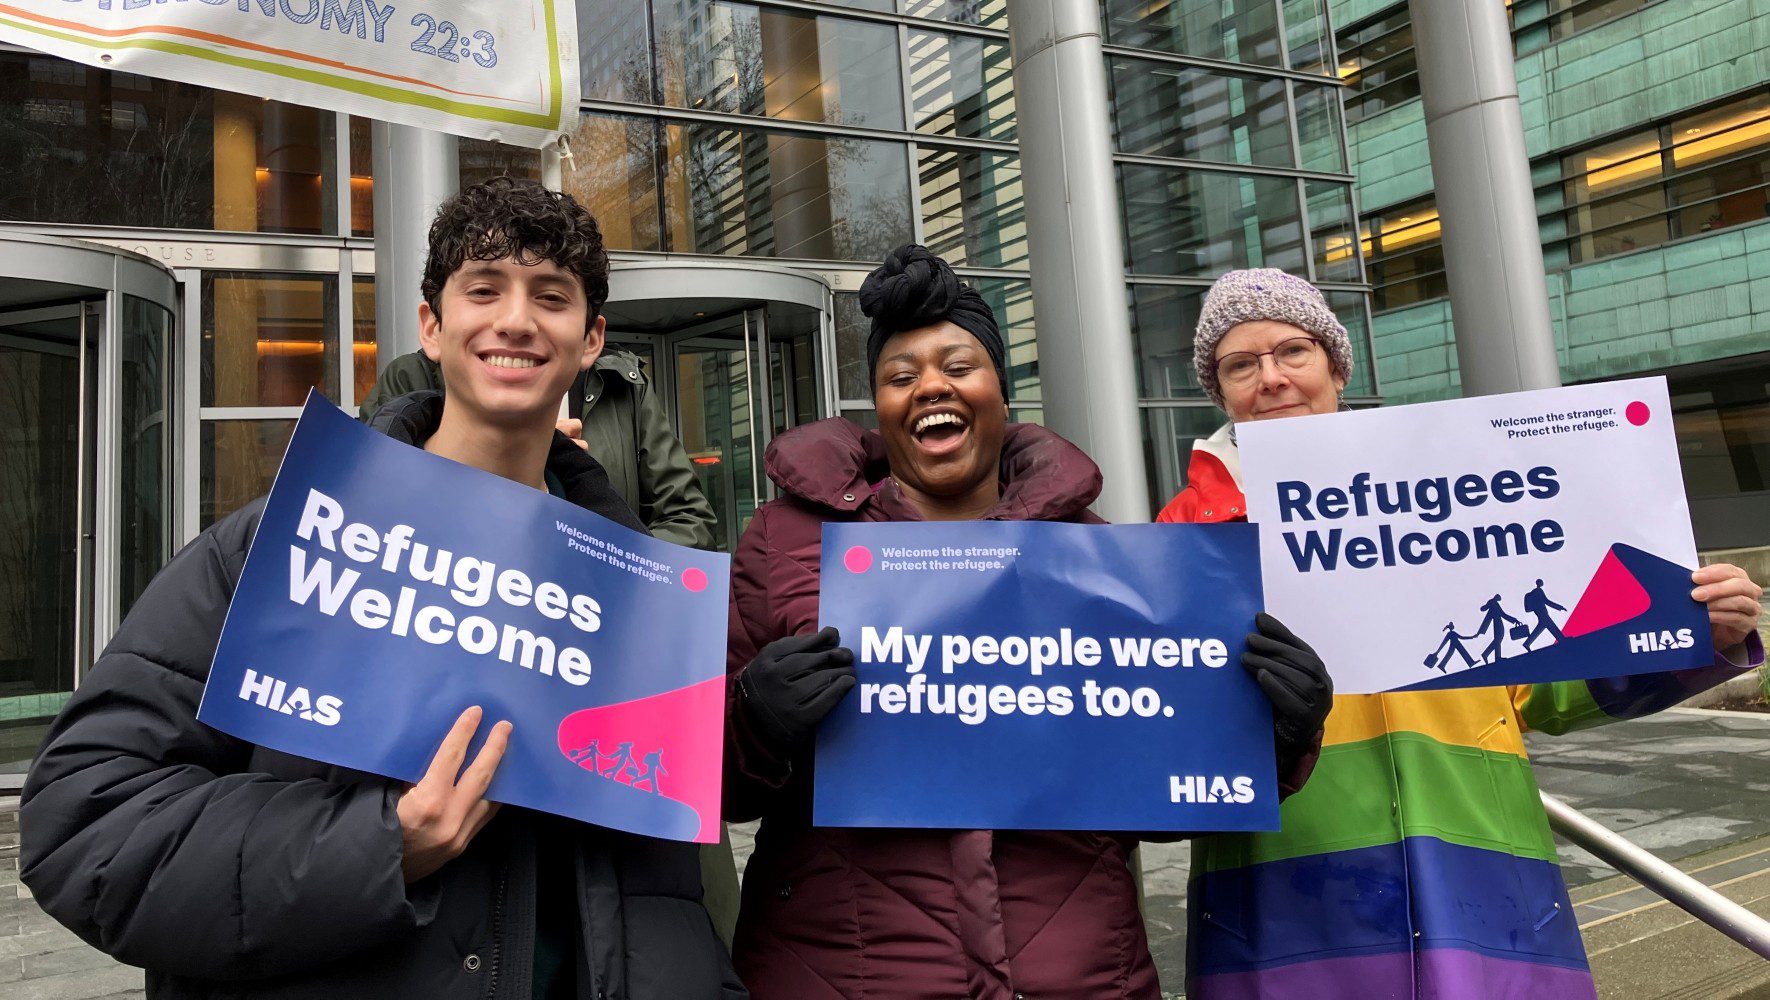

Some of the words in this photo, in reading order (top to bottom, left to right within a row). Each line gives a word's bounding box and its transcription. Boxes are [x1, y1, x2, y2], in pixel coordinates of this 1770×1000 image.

[410, 13, 498, 69] 22:3
[1490, 415, 1545, 429] Welcome
[1546, 412, 1565, 423] the
[1566, 407, 1616, 420] stranger.
[1507, 425, 1551, 439] Protect
[1552, 424, 1571, 434] the
[1572, 419, 1619, 432] refugee.
[1276, 465, 1560, 523] Refugees
[296, 488, 602, 633] Refugees
[555, 520, 606, 549] Welcome
[606, 542, 624, 557] the
[625, 551, 674, 574] stranger.
[567, 537, 608, 562] Protect
[608, 555, 626, 570] the
[627, 564, 673, 585] refugee.
[881, 547, 940, 558] Welcome
[941, 546, 963, 557] the
[964, 546, 1022, 560] stranger.
[881, 560, 928, 571] Protect
[929, 559, 951, 570] the
[952, 558, 1005, 572] refugee.
[1281, 519, 1565, 573] Welcome
[289, 545, 592, 686] Welcome
[860, 626, 933, 674] My
[942, 628, 1102, 676] people
[1109, 637, 1228, 668] were
[1628, 628, 1695, 655] HIAS
[238, 668, 344, 726] HIAS
[860, 673, 1074, 725] refugees
[1082, 680, 1175, 718] too.
[1169, 776, 1255, 804] HIAS
